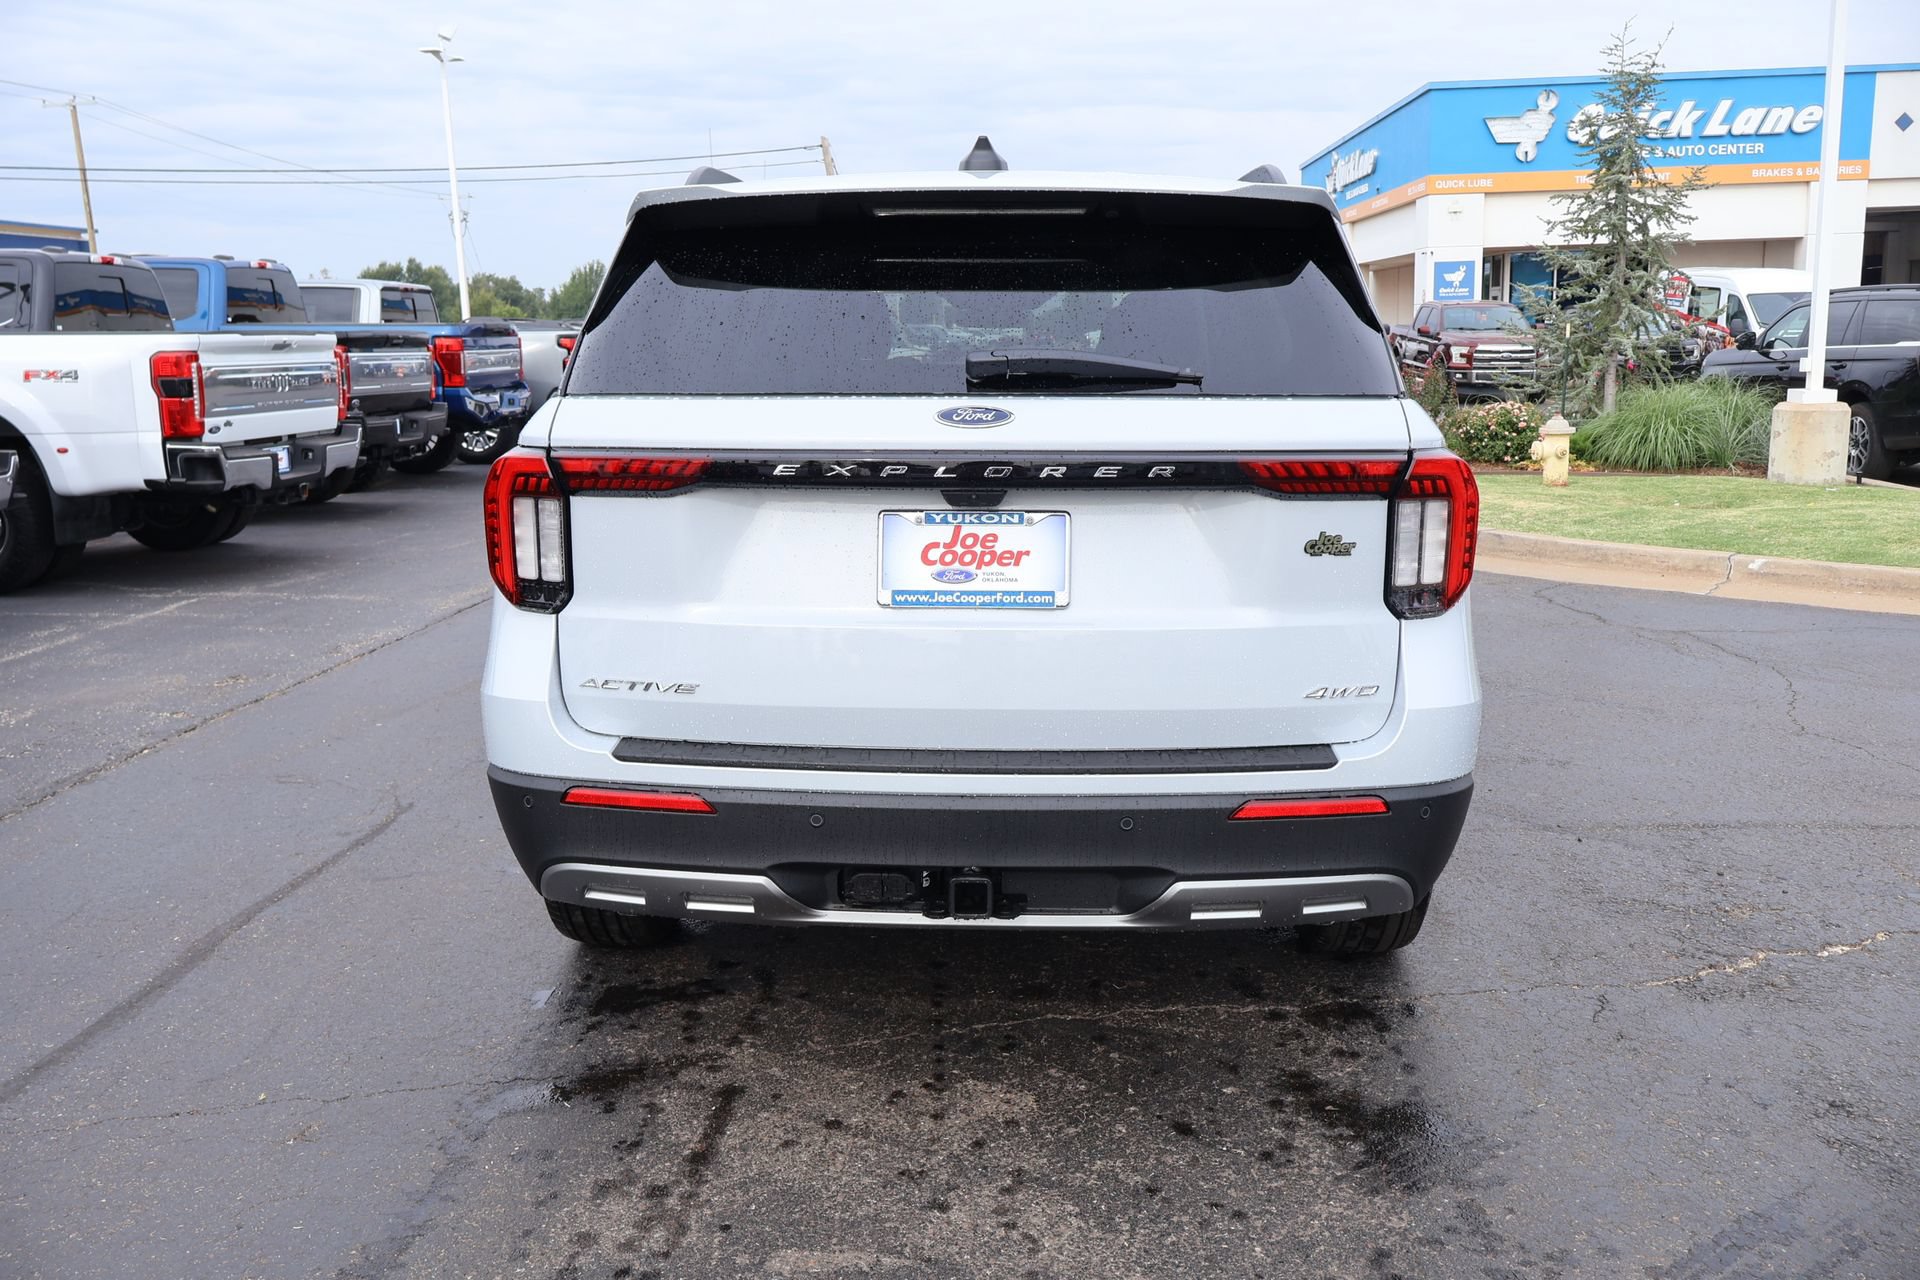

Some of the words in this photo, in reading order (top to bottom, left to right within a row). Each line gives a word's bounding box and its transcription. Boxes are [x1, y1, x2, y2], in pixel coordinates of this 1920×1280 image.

[1703, 99, 1824, 138] Lane
[1665, 145, 1705, 157] AUTO
[1708, 143, 1764, 155] CENTER
[1752, 168, 1794, 177] BRAKES
[1796, 167, 1803, 176] &
[1435, 179, 1465, 189] QUICK
[1468, 178, 1493, 188] LUBE
[23, 370, 78, 382] FX4
[952, 408, 996, 420] Ford
[772, 464, 1176, 478] EXPLORER
[931, 513, 1020, 524] YUKON
[943, 525, 998, 549] Joe
[1318, 531, 1343, 545] Joe
[1304, 540, 1357, 554] Cooper
[920, 541, 1030, 570] Cooper
[894, 591, 1053, 605] www.JoeCooperFord.com
[579, 678, 700, 694] ACTIVE
[1304, 685, 1379, 699] 4WD
